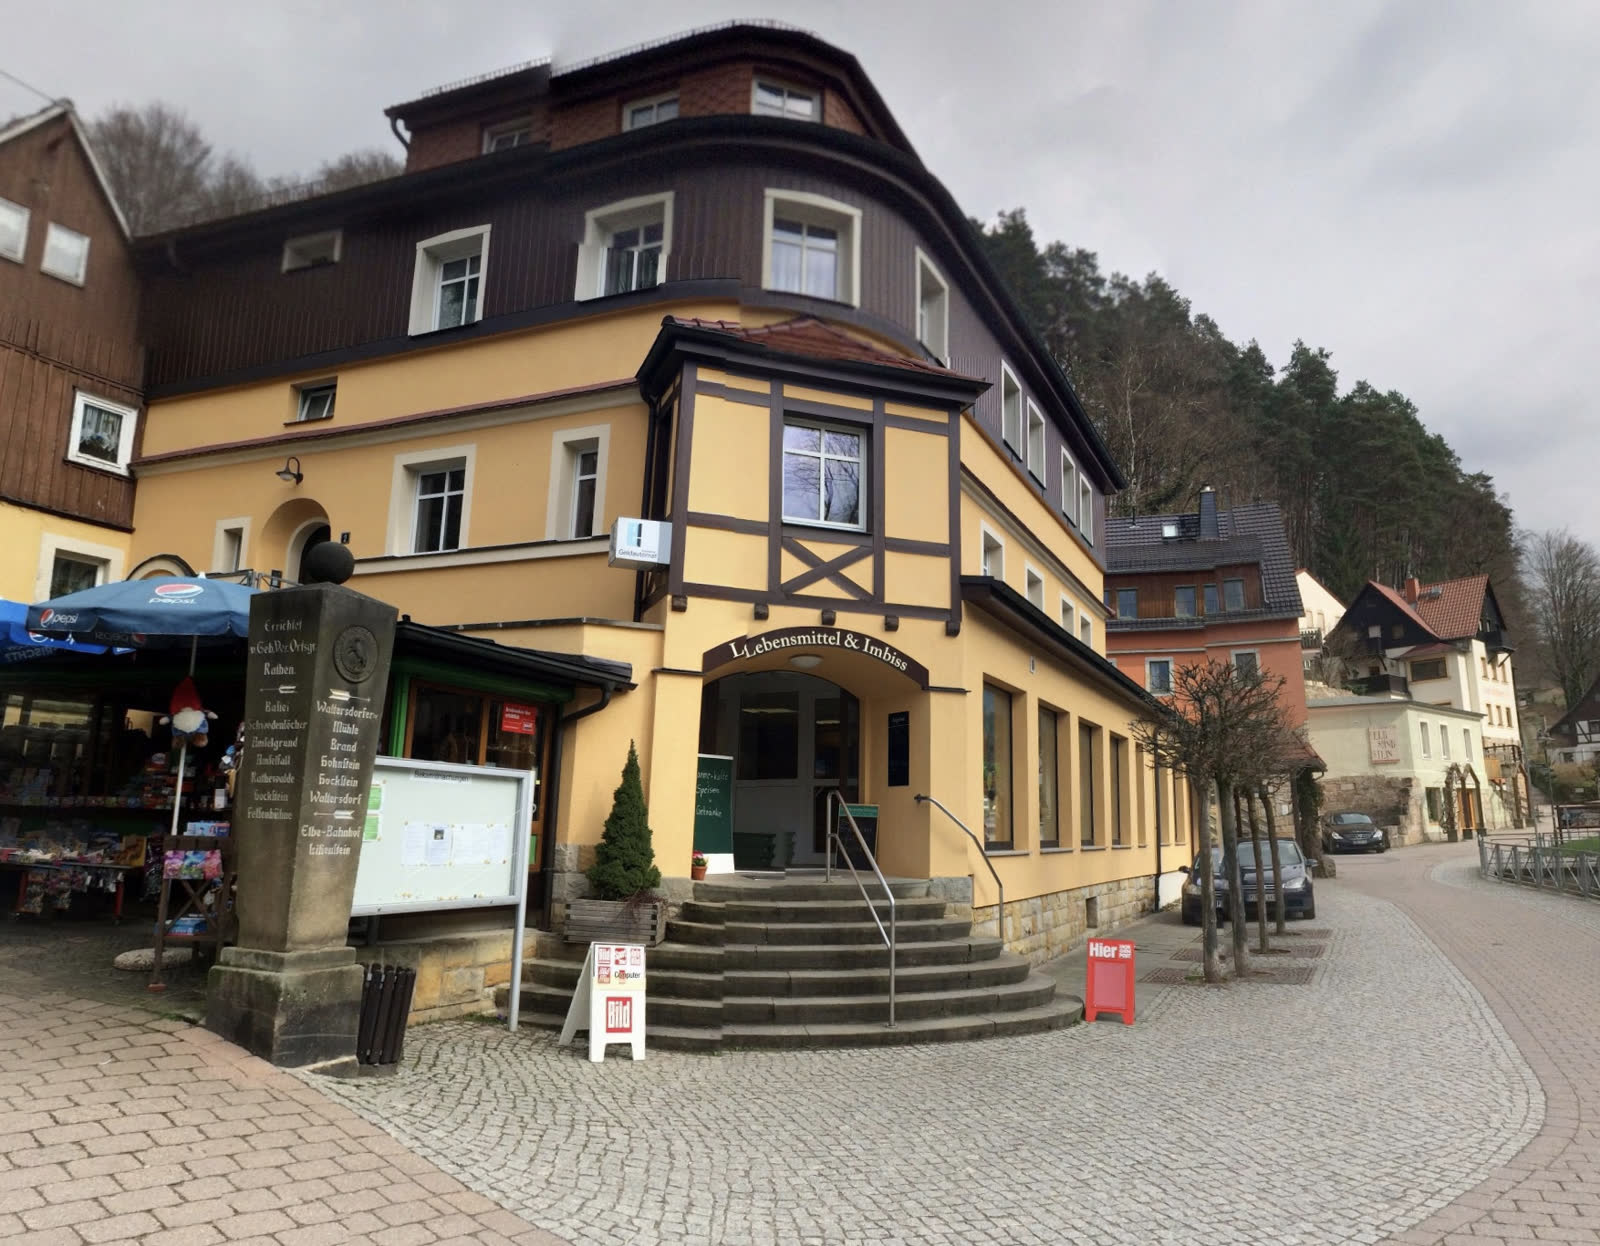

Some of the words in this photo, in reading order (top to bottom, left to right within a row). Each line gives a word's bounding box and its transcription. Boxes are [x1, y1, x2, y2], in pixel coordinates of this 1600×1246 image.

[149, 597, 198, 605] pepsi
[51, 613, 79, 625] pepsi
[844, 633, 860, 650] &
[862, 637, 908, 672] Imbiss
[332, 720, 359, 735] Mühle
[330, 738, 358, 752] Brand
[309, 790, 362, 805] Waltersdorf
[301, 824, 362, 838] Elbe-Bahnhof
[1089, 941, 1117, 959] Hier
[607, 1000, 631, 1029] Bild
